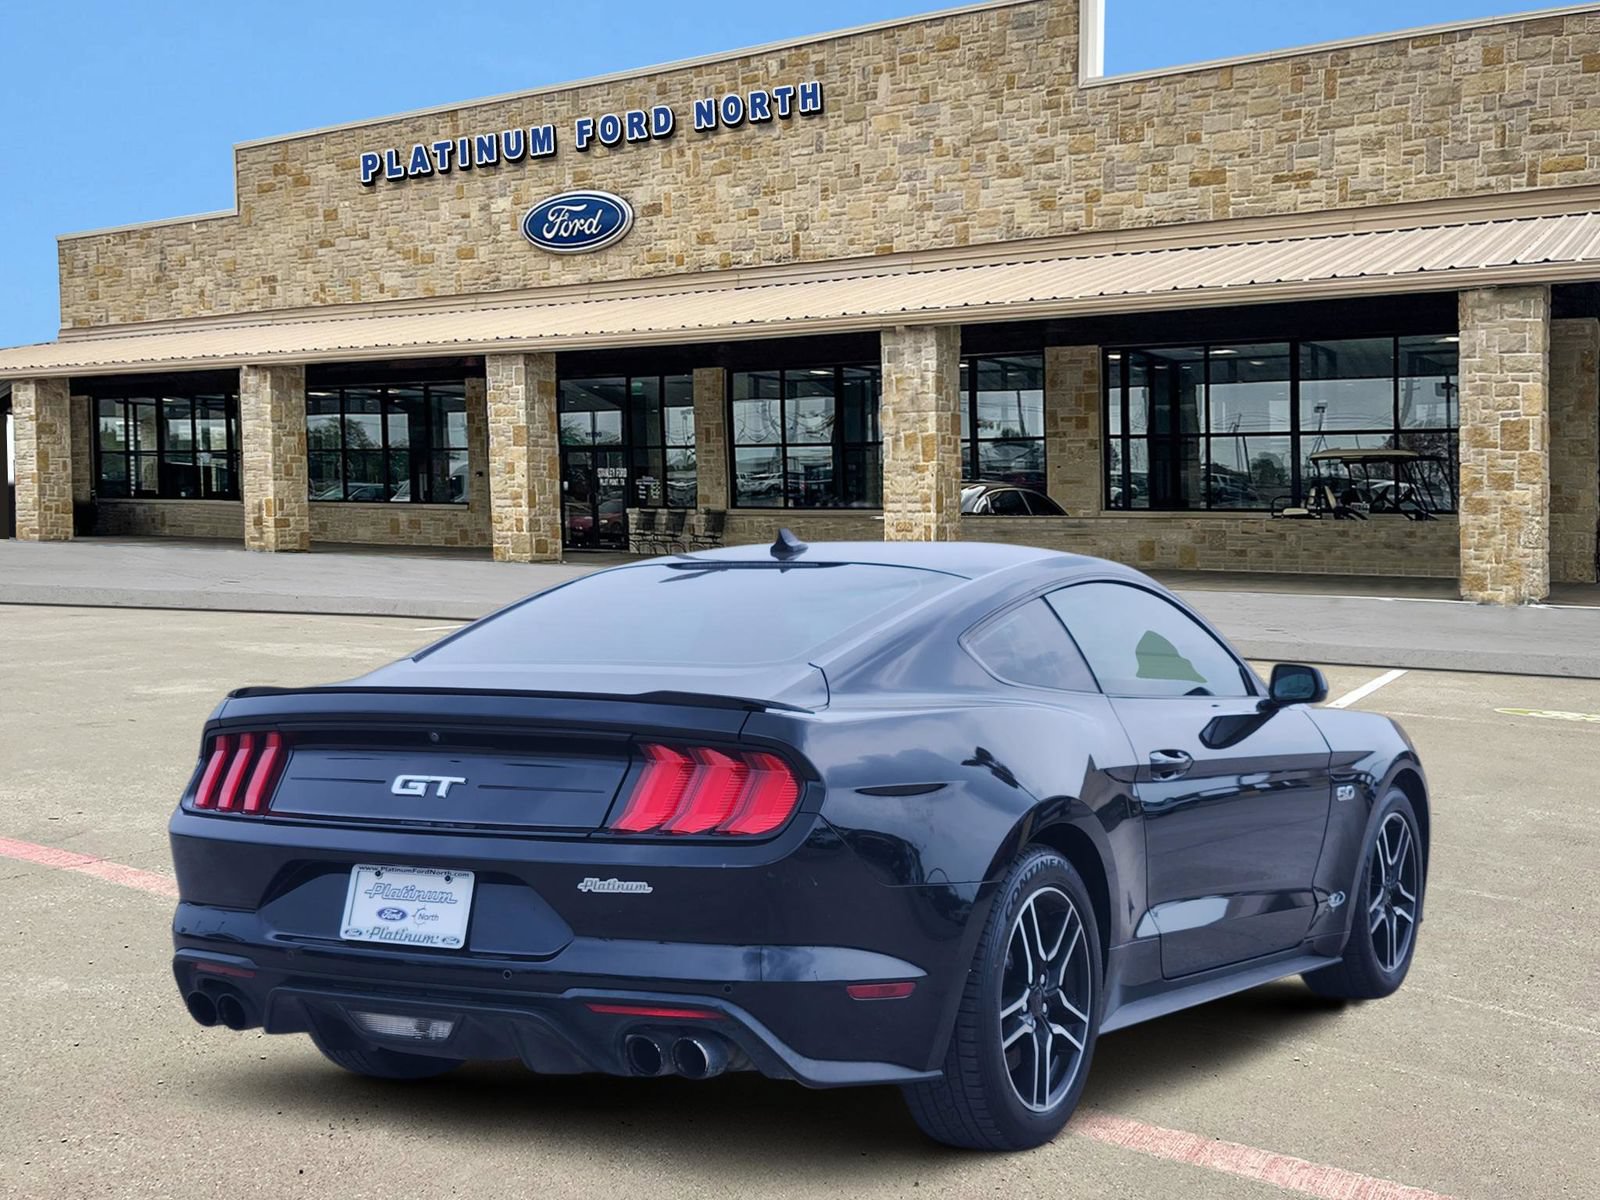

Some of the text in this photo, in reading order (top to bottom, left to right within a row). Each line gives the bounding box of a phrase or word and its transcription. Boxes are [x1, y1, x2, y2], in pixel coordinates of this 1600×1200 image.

[360, 81, 823, 185] PLATINUM FORD NORTH
[541, 205, 602, 240] Ford
[391, 774, 467, 798] GT
[358, 866, 470, 877] www.PlatinumFordNorth.com
[365, 882, 457, 904] Platinum
[577, 877, 653, 893] Platinum
[382, 909, 403, 920] Ford
[418, 912, 440, 921] North
[368, 926, 438, 944] Platinum
